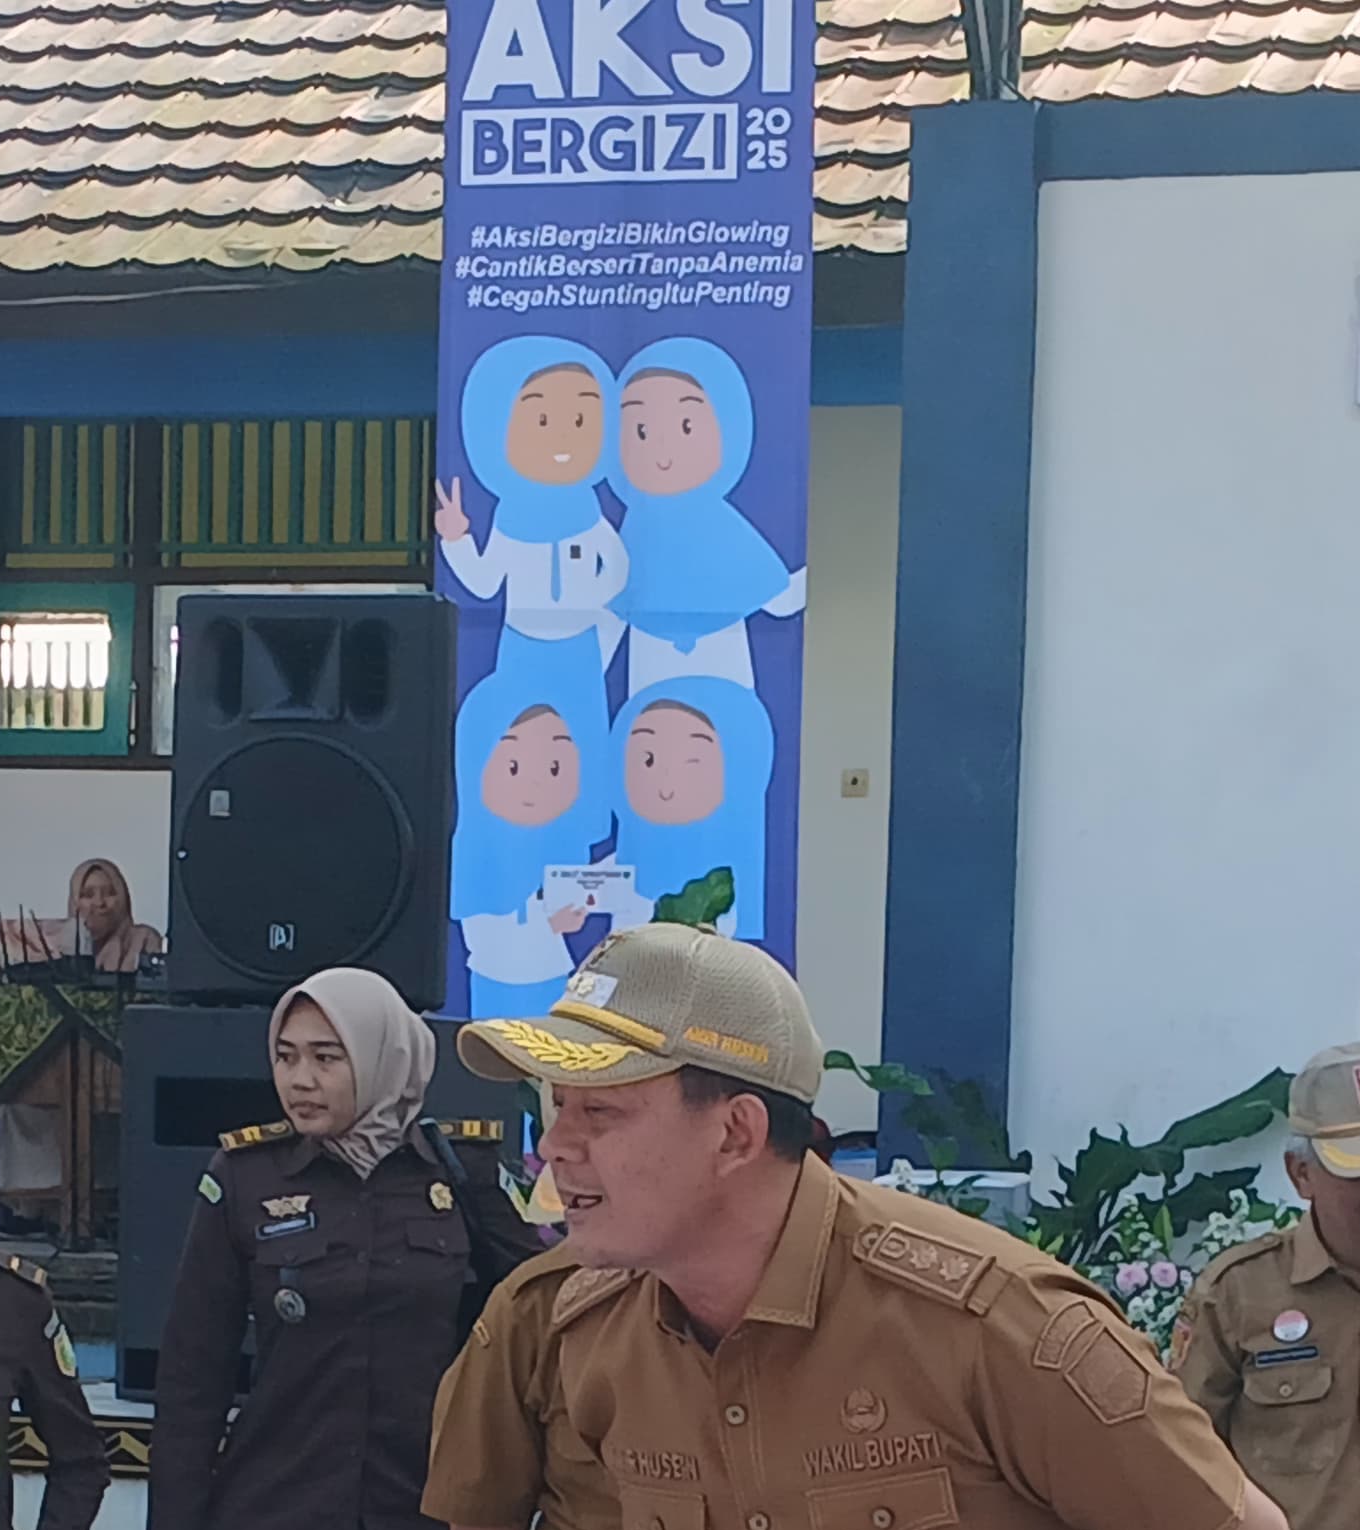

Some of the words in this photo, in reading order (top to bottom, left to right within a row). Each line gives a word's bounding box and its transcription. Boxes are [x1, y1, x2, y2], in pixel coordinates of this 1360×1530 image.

[462, 0, 793, 101] AKSI
[745, 106, 792, 137] 20
[472, 112, 727, 177] BERGIZI
[746, 139, 789, 170] 25
[470, 219, 790, 251] #AksiBergiziBikinGlowing
[454, 252, 804, 280] #CantikBerseriTanpaAnemia
[466, 281, 791, 311] #CegahStuntingItuPenting
[802, 1442, 865, 1478] WAKIL
[865, 1432, 941, 1470] BUPATI
